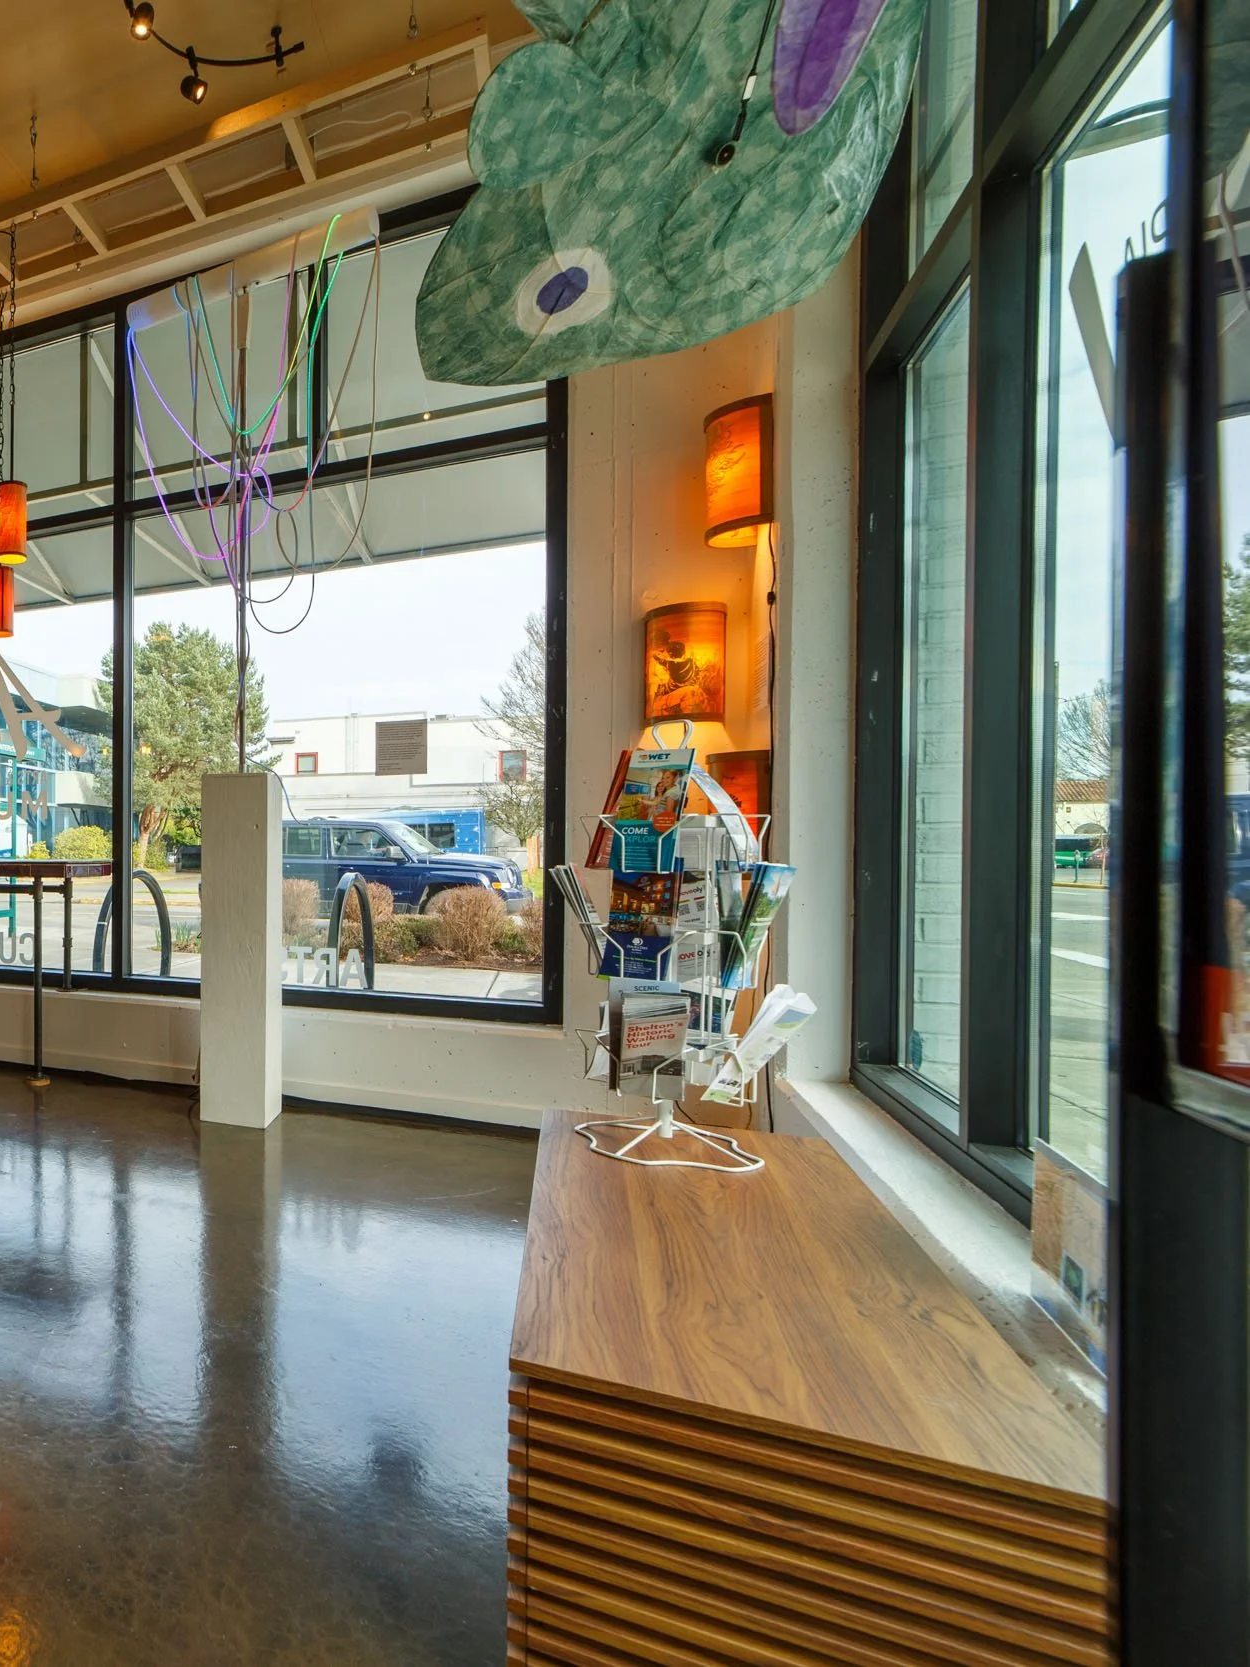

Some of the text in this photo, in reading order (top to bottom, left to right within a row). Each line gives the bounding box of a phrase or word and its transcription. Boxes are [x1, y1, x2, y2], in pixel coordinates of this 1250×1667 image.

[648, 753, 671, 761] WET
[621, 827, 649, 835] COME
[625, 835, 656, 843] XPLOR
[627, 1021, 685, 1033] Shelton's
[626, 1028, 674, 1039] Historic
[626, 1033, 676, 1043] Walking
[625, 1041, 652, 1050] Tour
